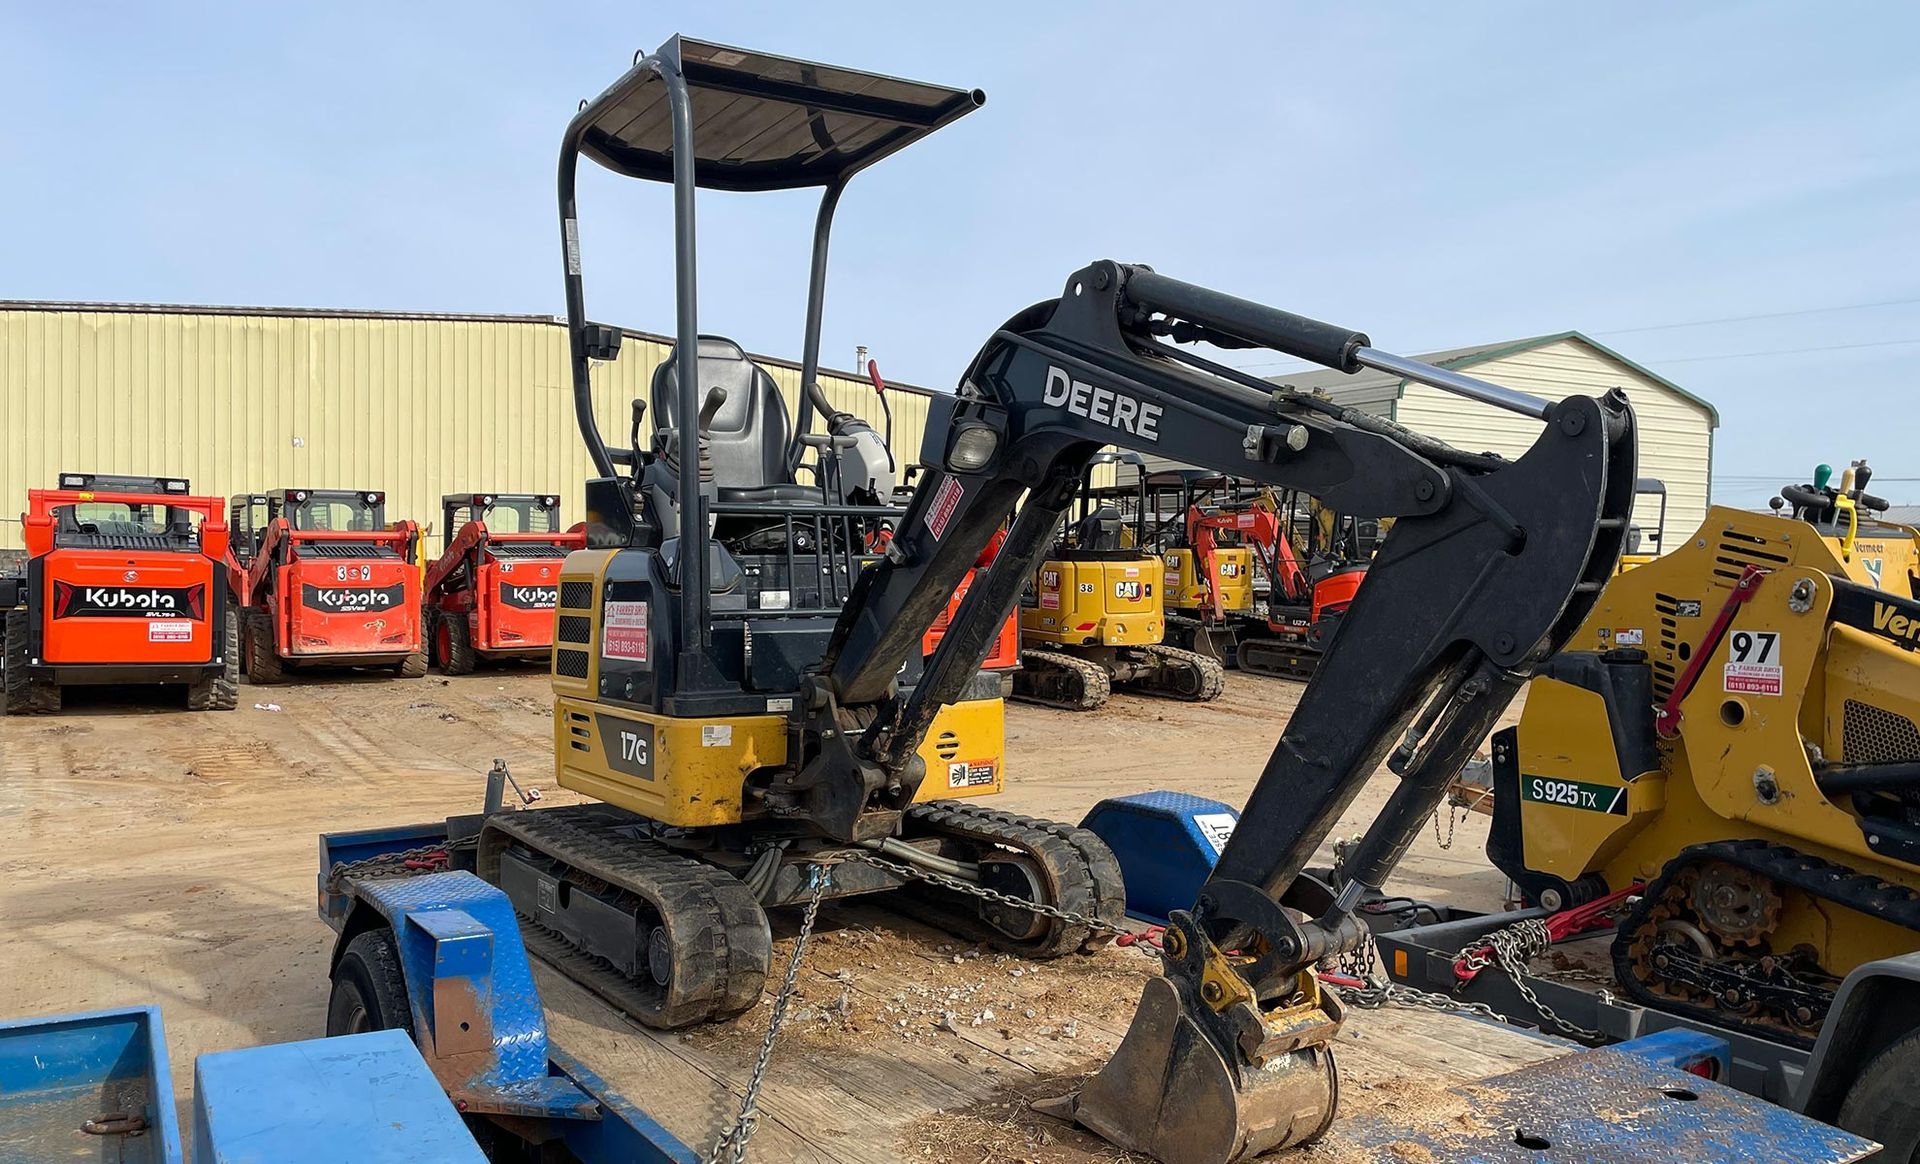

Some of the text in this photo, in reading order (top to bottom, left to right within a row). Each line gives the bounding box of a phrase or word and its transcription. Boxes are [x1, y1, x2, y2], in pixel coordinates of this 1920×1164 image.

[1043, 365, 1163, 441] DEERE
[1853, 541, 1884, 554] Vermeer
[501, 563, 513, 572] 42
[1166, 556, 1179, 567] CAT
[1221, 563, 1236, 576] CAT
[1043, 571, 1059, 587] CAT
[513, 587, 558, 602] Kubo
[1080, 583, 1094, 593] 38
[1115, 582, 1140, 599] CAT
[86, 588, 175, 608] Kubota
[318, 589, 389, 605] Kubota
[1873, 601, 1920, 641] Ver
[607, 639, 645, 654] (615) 893-6118
[1732, 632, 1777, 664] 97
[1727, 680, 1746, 689] (615)
[1746, 682, 1779, 692] 893-6118
[620, 731, 647, 765] 17G
